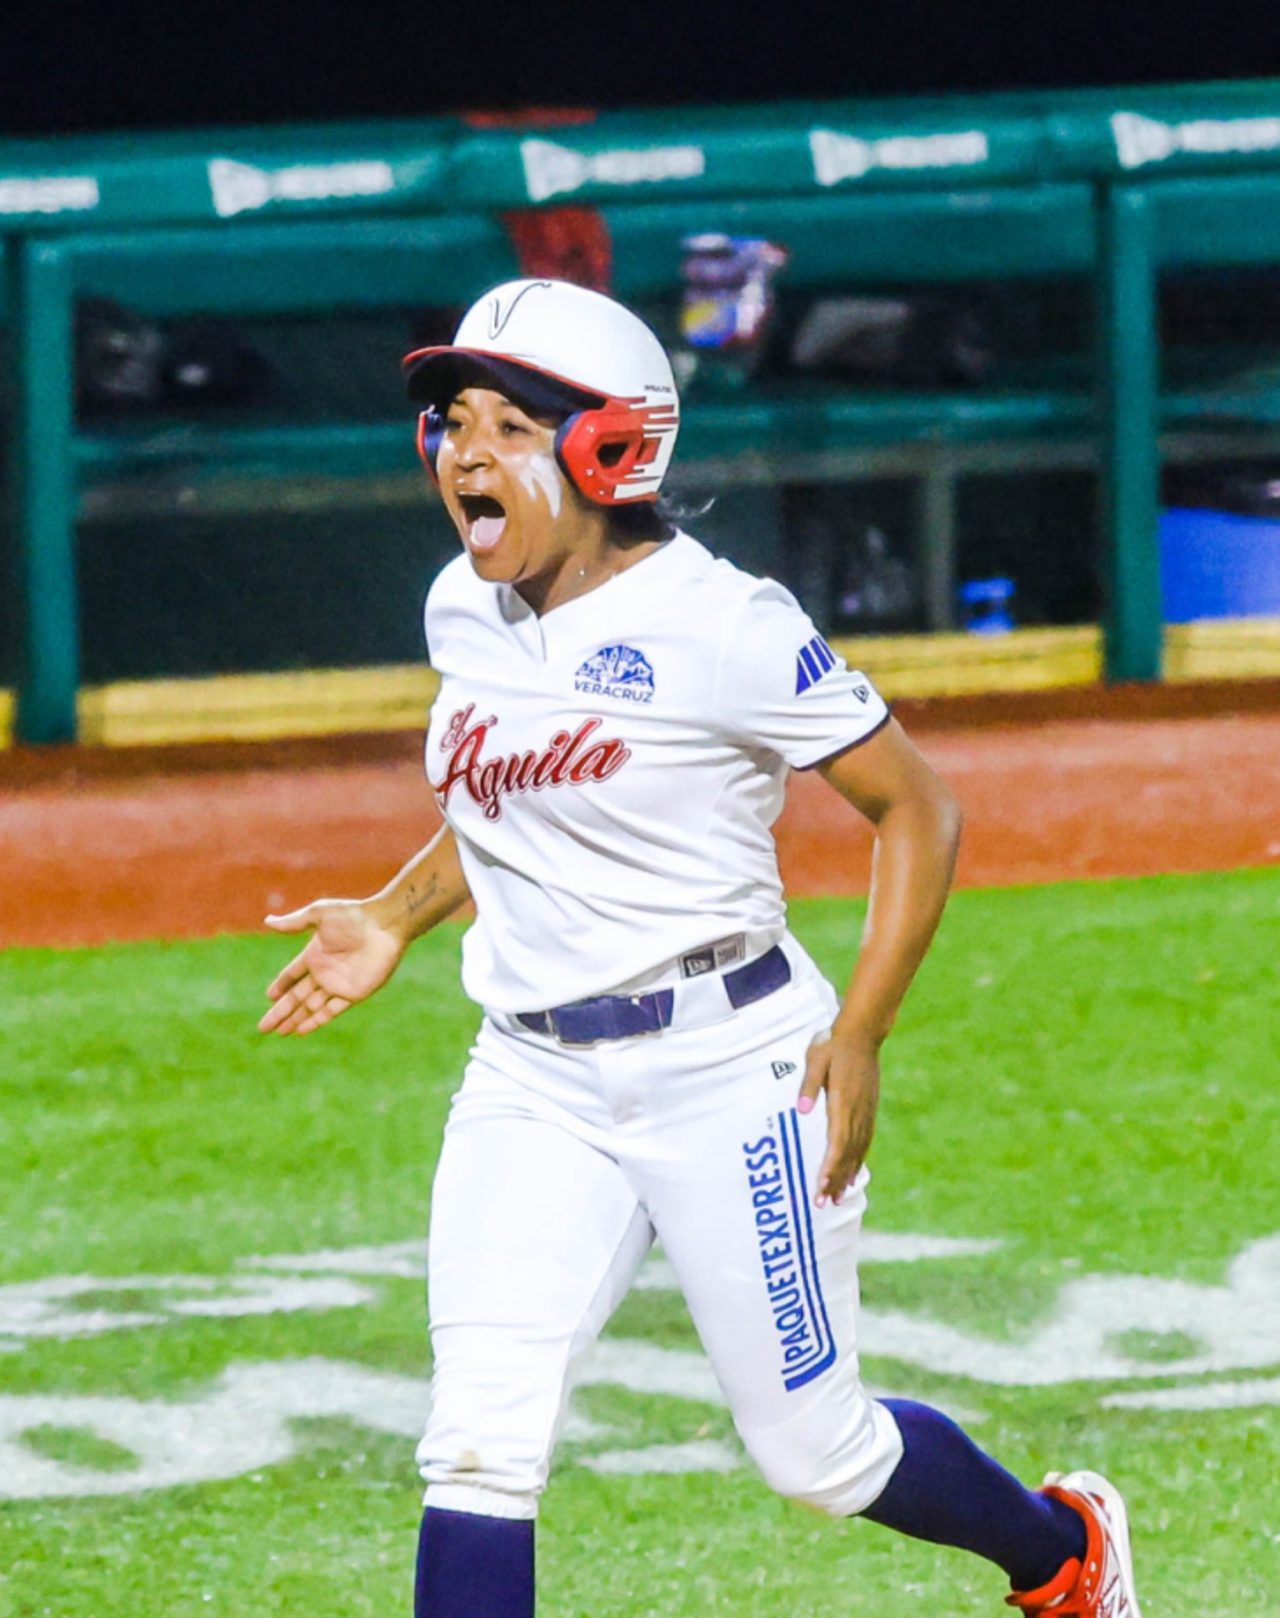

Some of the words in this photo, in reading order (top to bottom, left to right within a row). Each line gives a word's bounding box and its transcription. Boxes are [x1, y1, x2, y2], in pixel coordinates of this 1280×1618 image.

[439, 702, 477, 752] El
[574, 679, 654, 704] VERACRUZ
[434, 717, 631, 824] Aguila
[743, 1135, 814, 1364] PAQUETEXPRESS
